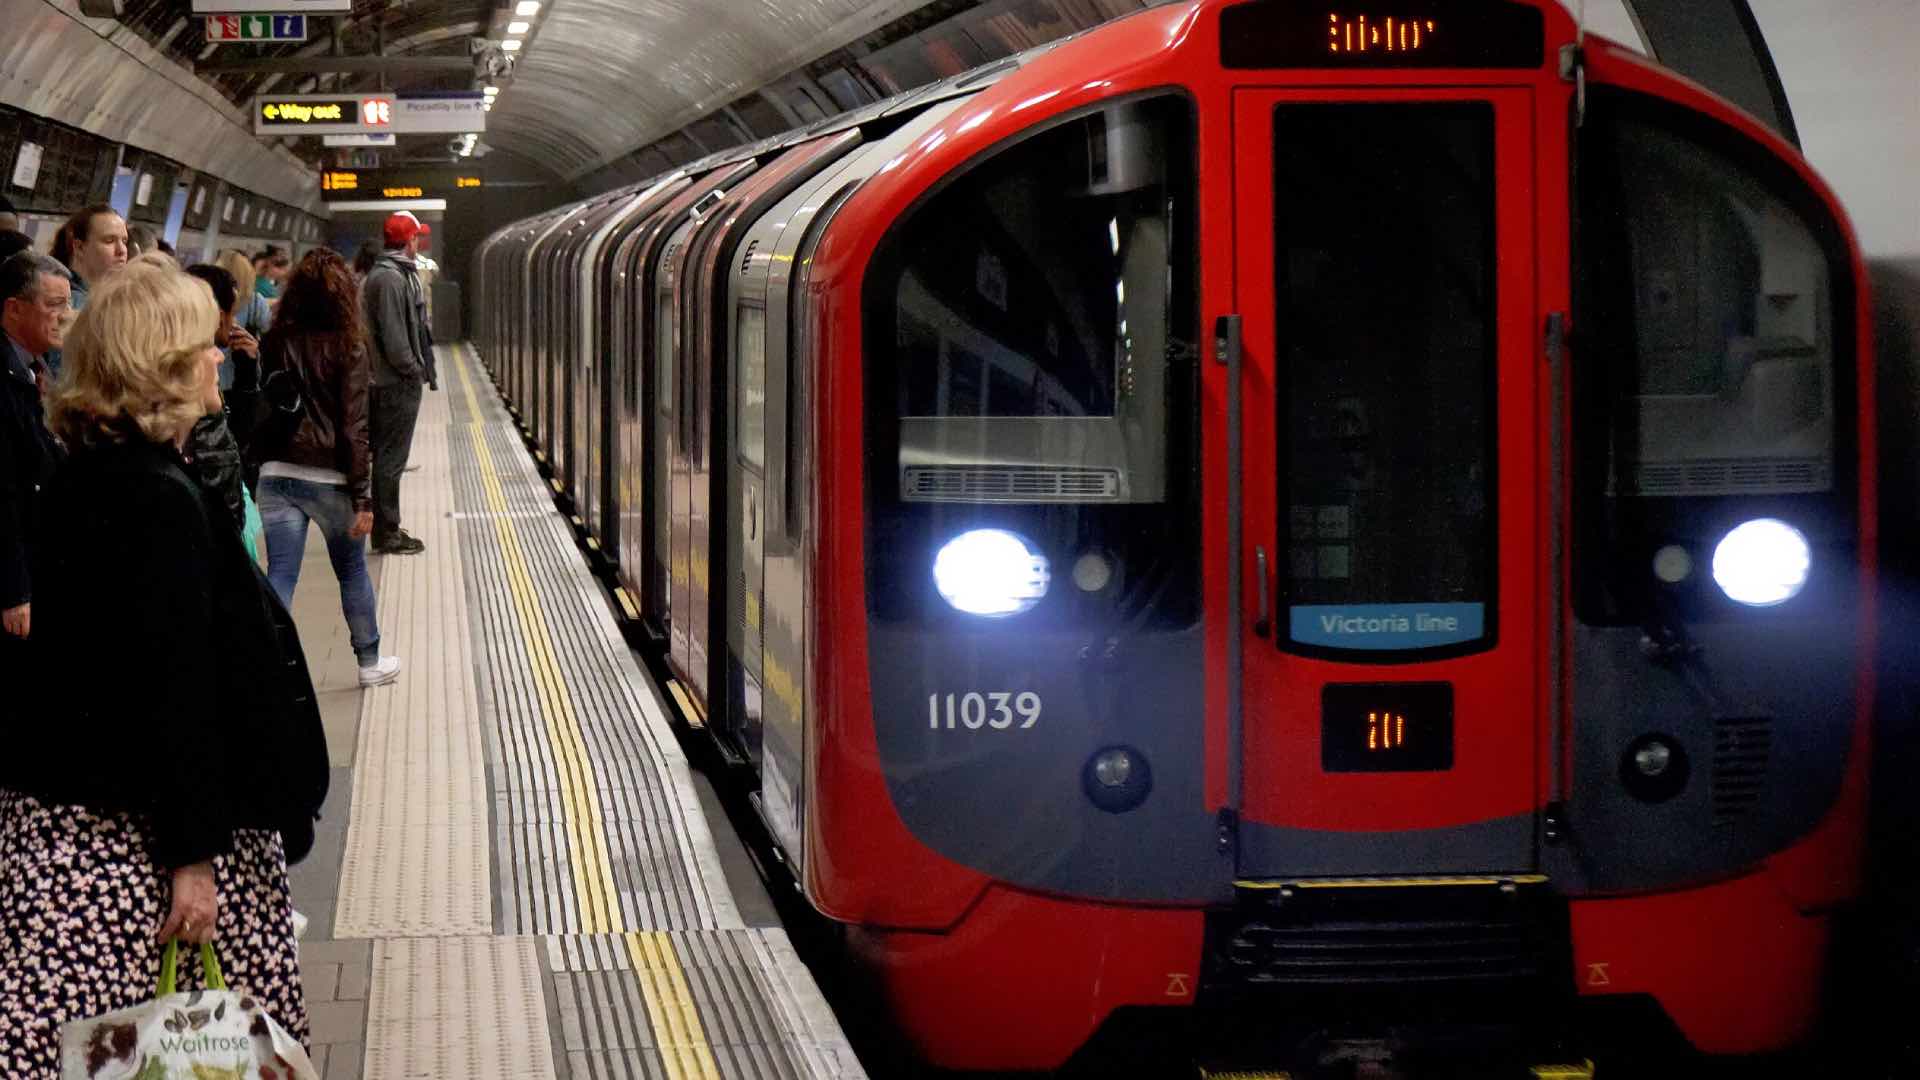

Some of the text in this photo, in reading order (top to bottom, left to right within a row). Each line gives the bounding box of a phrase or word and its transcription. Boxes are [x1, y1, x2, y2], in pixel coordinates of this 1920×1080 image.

[279, 104, 341, 122] Way out
[1320, 613, 1457, 633] Victoria line
[929, 691, 1041, 729] 11039
[160, 1033, 249, 1054] Waitrose
